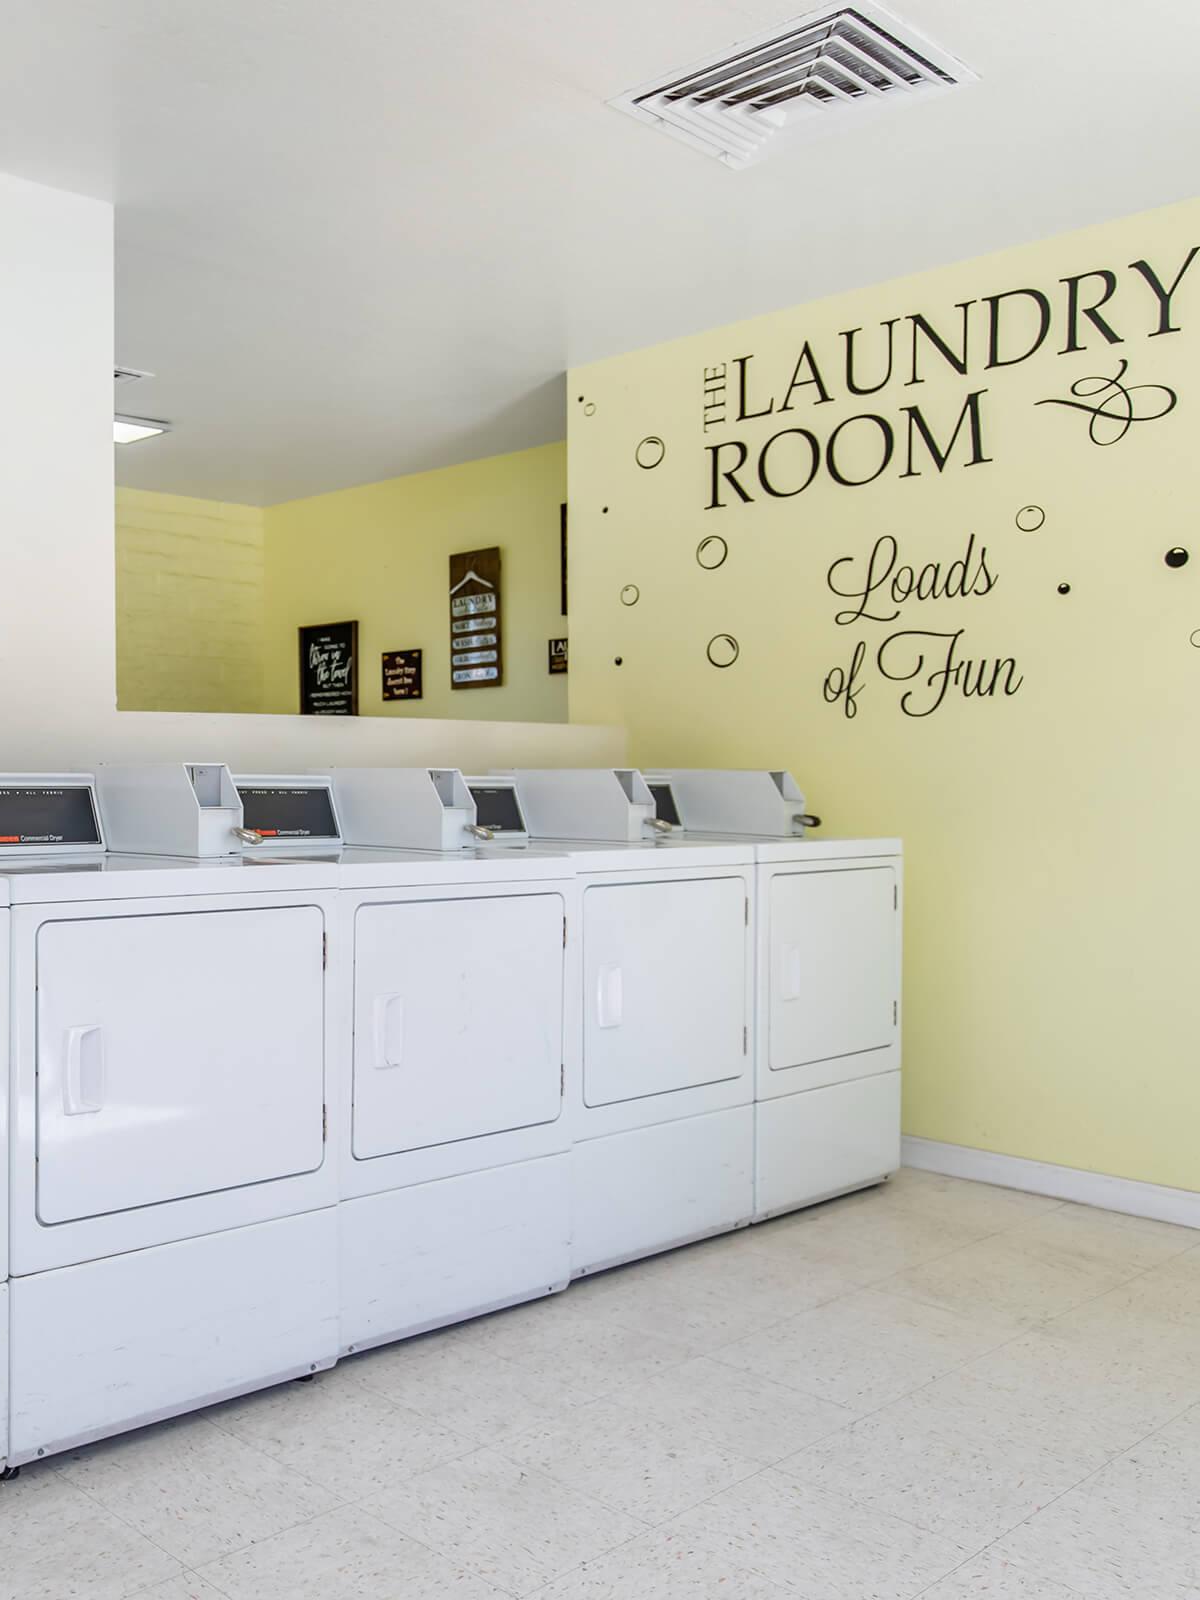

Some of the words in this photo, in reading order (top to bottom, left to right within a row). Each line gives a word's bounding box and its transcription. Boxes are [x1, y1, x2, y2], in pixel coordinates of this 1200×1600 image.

[732, 246, 1200, 423] LAUNDRY
[704, 362, 727, 434] THE
[704, 388, 994, 510] ROOM
[827, 533, 999, 626] Loads
[823, 640, 867, 719] of
[877, 628, 1024, 718] Fun
